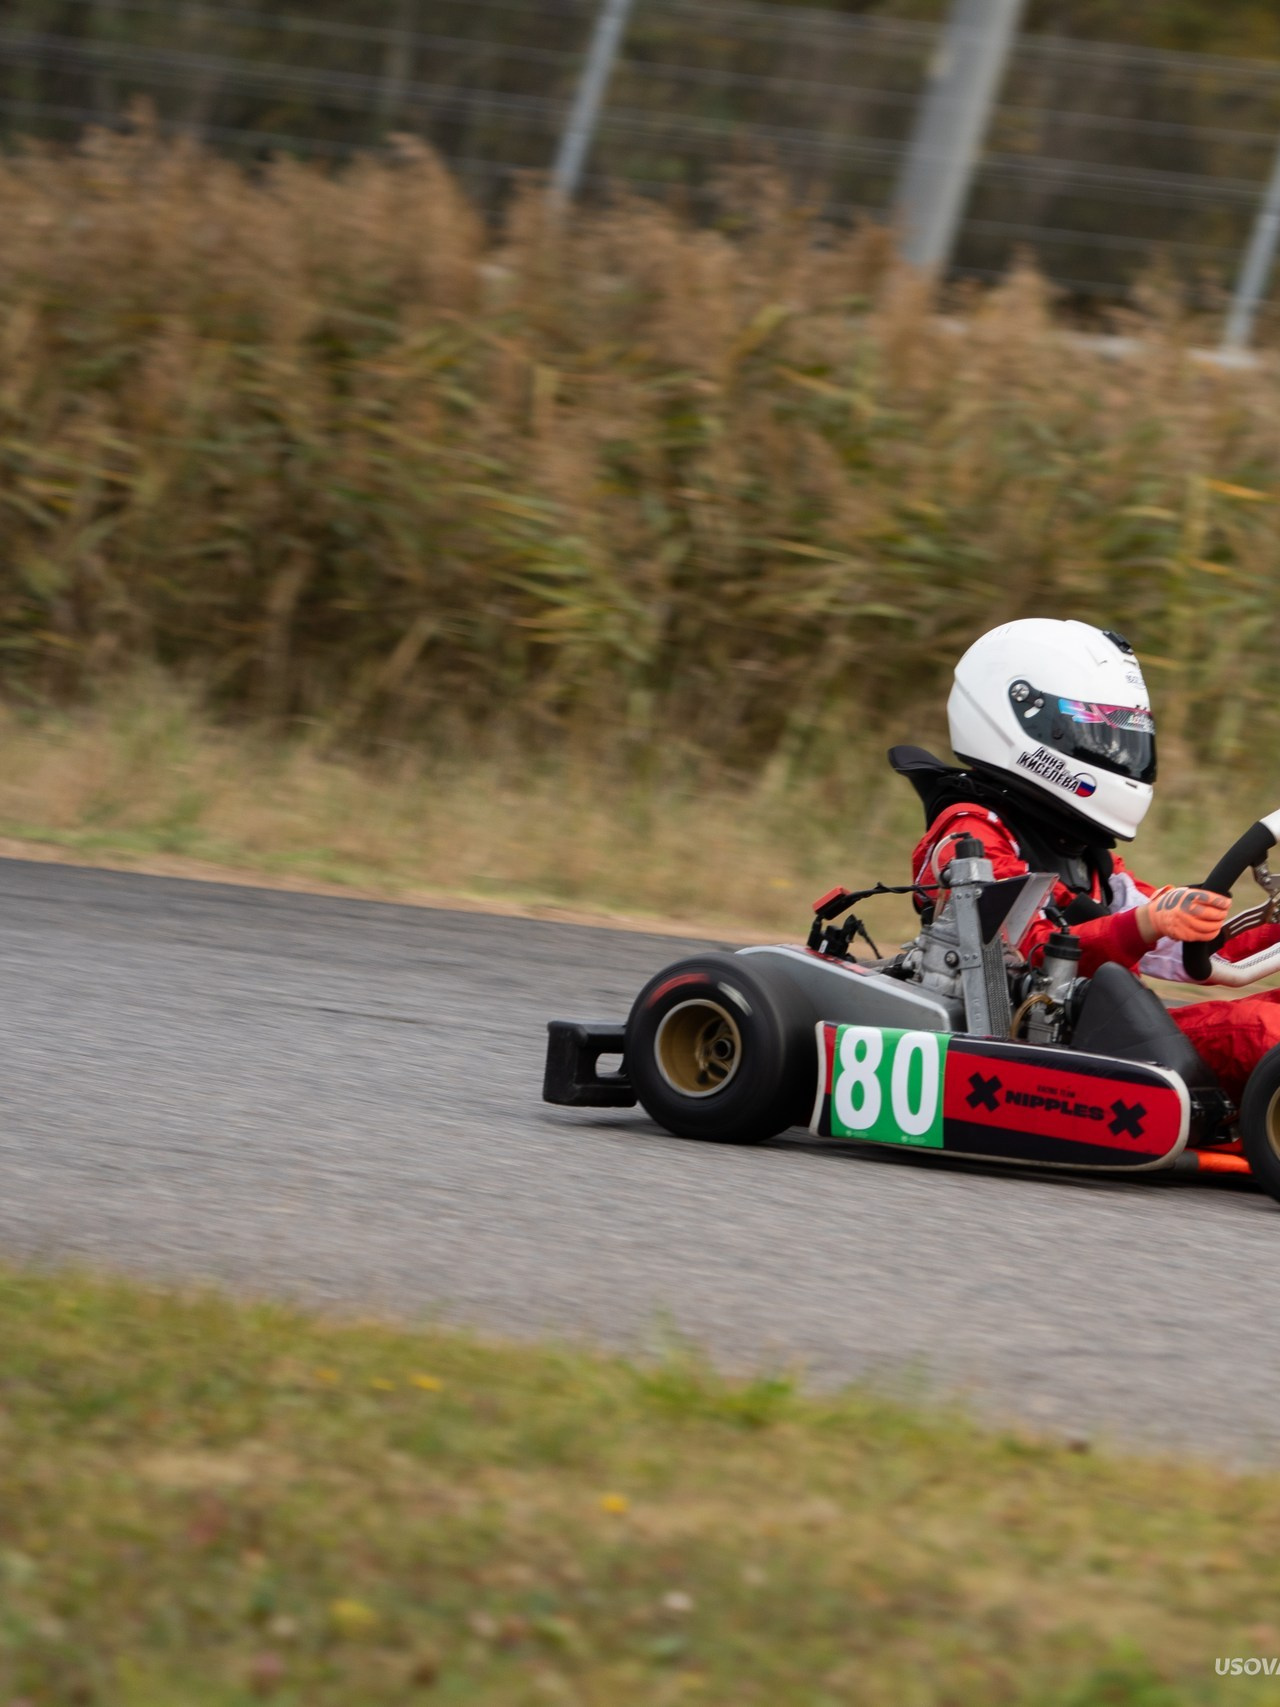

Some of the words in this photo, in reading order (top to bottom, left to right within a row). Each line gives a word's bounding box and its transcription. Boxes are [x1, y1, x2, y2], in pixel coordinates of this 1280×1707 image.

[1033, 749, 1066, 771] Анна
[835, 1026, 940, 1136] 80
[1005, 1090, 1105, 1121] NIPPLES
